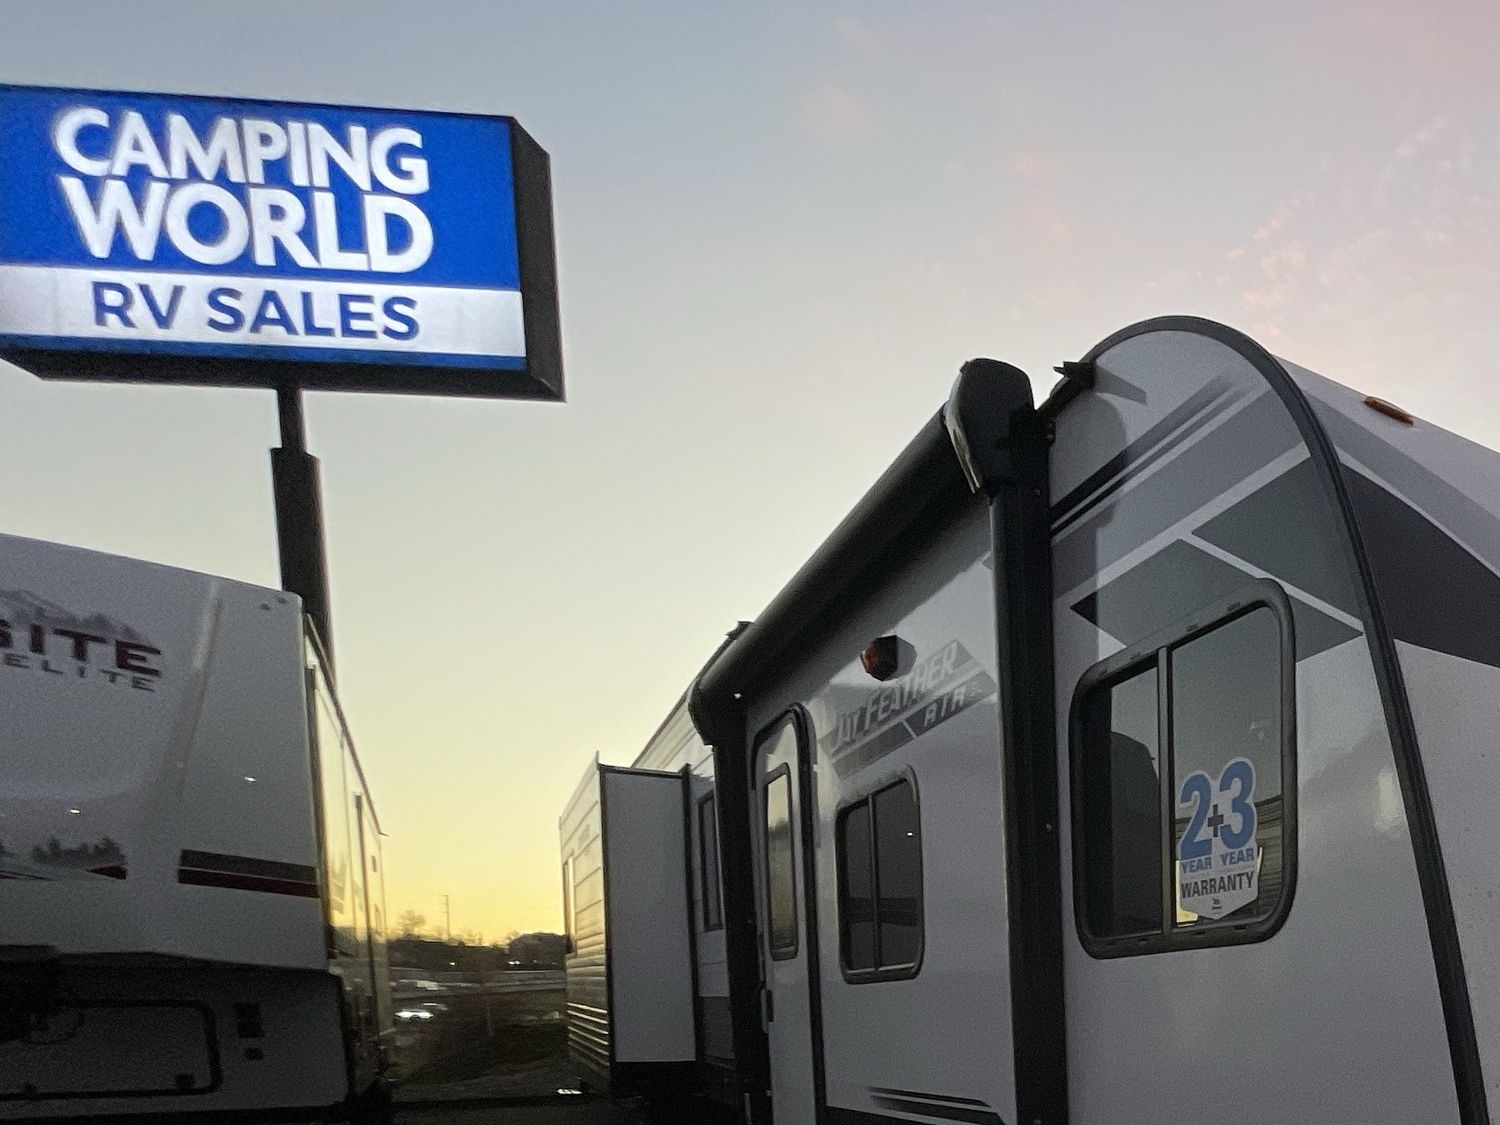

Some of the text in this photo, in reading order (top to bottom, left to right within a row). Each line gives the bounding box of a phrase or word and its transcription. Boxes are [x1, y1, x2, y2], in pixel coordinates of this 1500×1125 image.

[53, 107, 430, 194] CAMPING
[58, 176, 434, 273] WORLD
[92, 281, 420, 340] RV SALES
[0, 618, 162, 677] ITE
[4, 653, 155, 692] ELITE
[1181, 848, 1255, 874] YEAR YEAR
[1181, 871, 1255, 899] WARRANTY
